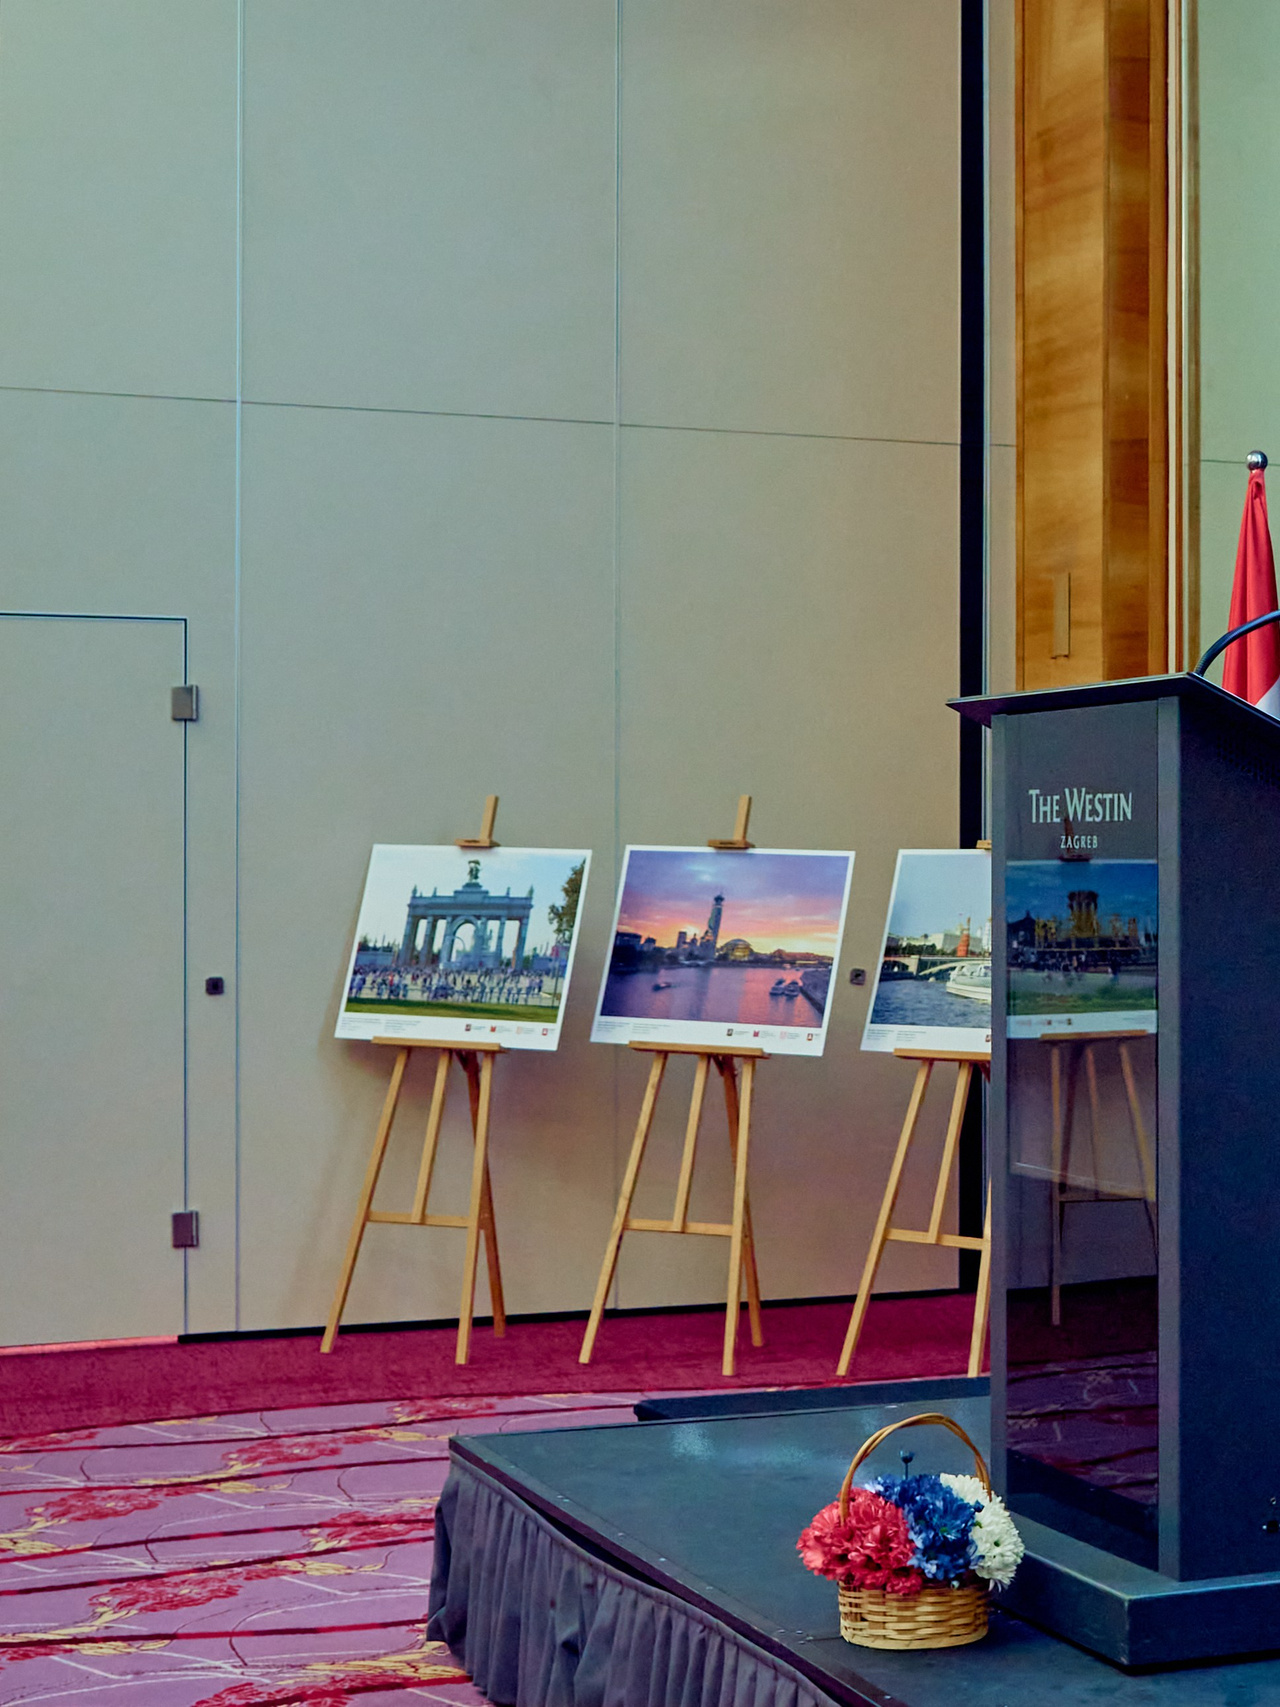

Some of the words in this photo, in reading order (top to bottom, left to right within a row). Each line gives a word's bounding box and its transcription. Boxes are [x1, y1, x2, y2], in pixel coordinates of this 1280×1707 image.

[1028, 789, 1061, 823] THE
[1064, 787, 1132, 822] WESTIN
[1060, 835, 1098, 849] ZAGREB
